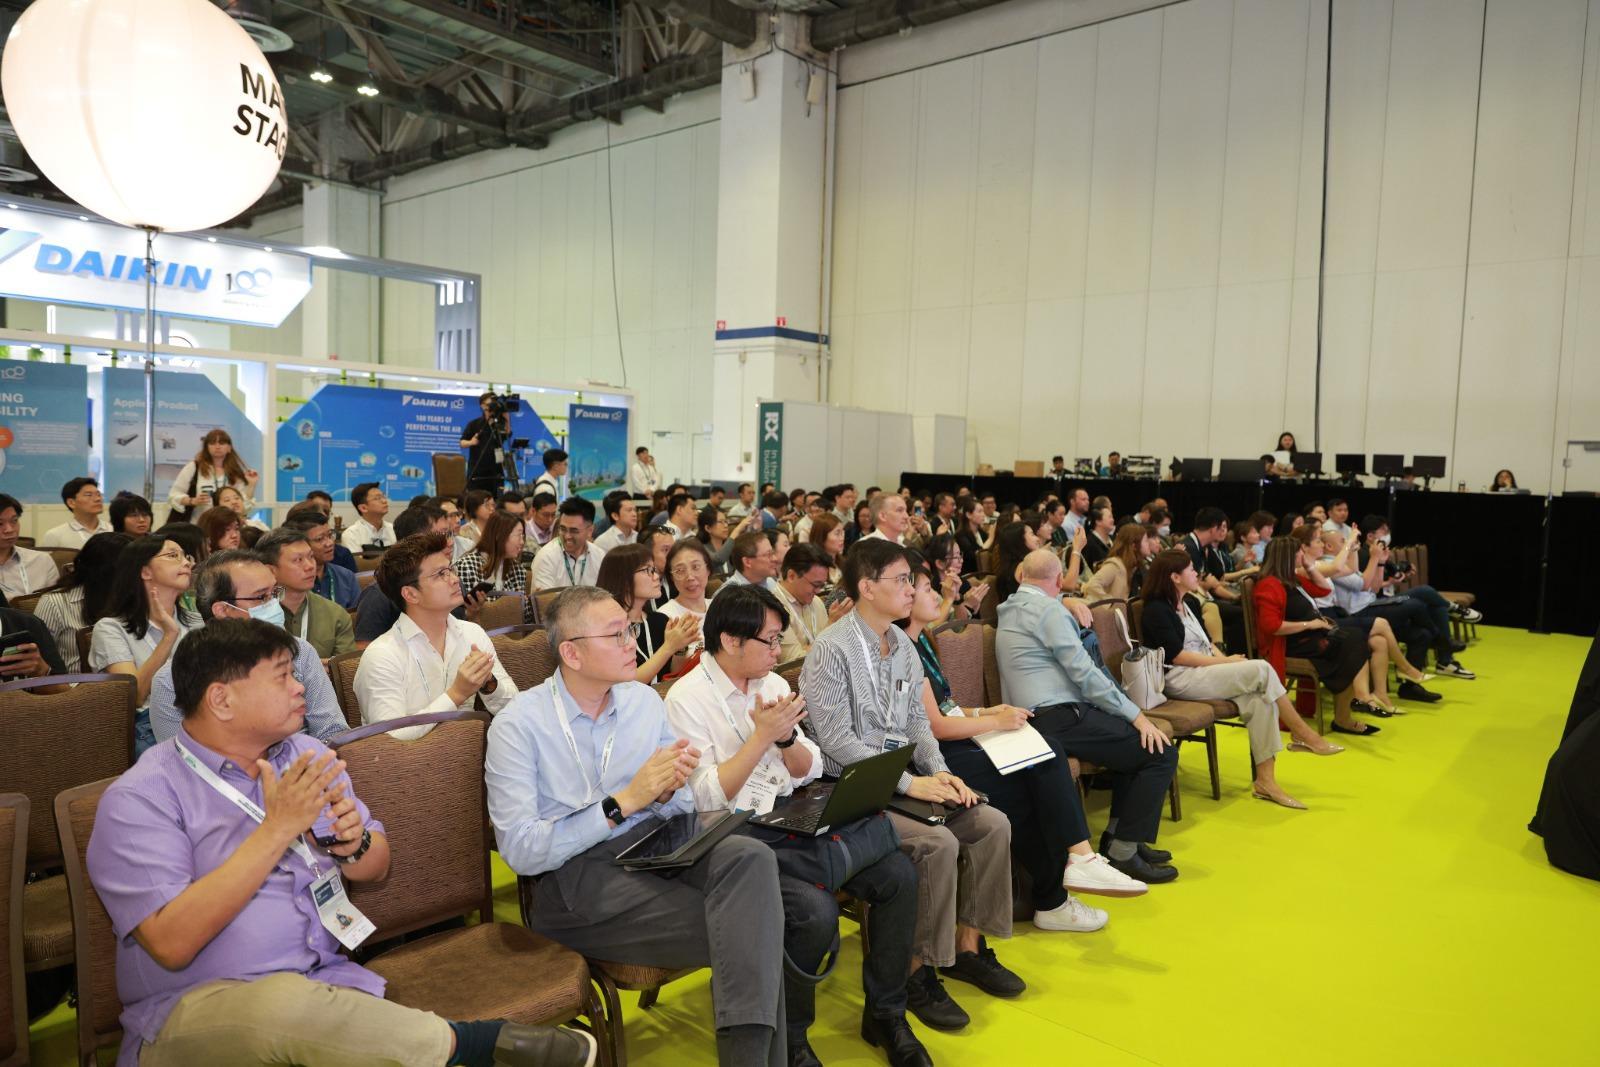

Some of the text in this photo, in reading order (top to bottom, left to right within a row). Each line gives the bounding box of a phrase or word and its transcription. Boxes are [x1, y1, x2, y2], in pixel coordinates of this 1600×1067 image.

[34, 243, 212, 291] DAIKIN
[113, 397, 199, 411] Applie Product
[412, 398, 449, 408] DAIKIN
[0, 405, 38, 417] ILITY
[582, 410, 610, 419] DAIKIN
[427, 415, 444, 423] YEARS
[405, 423, 439, 432] PERFECTING
